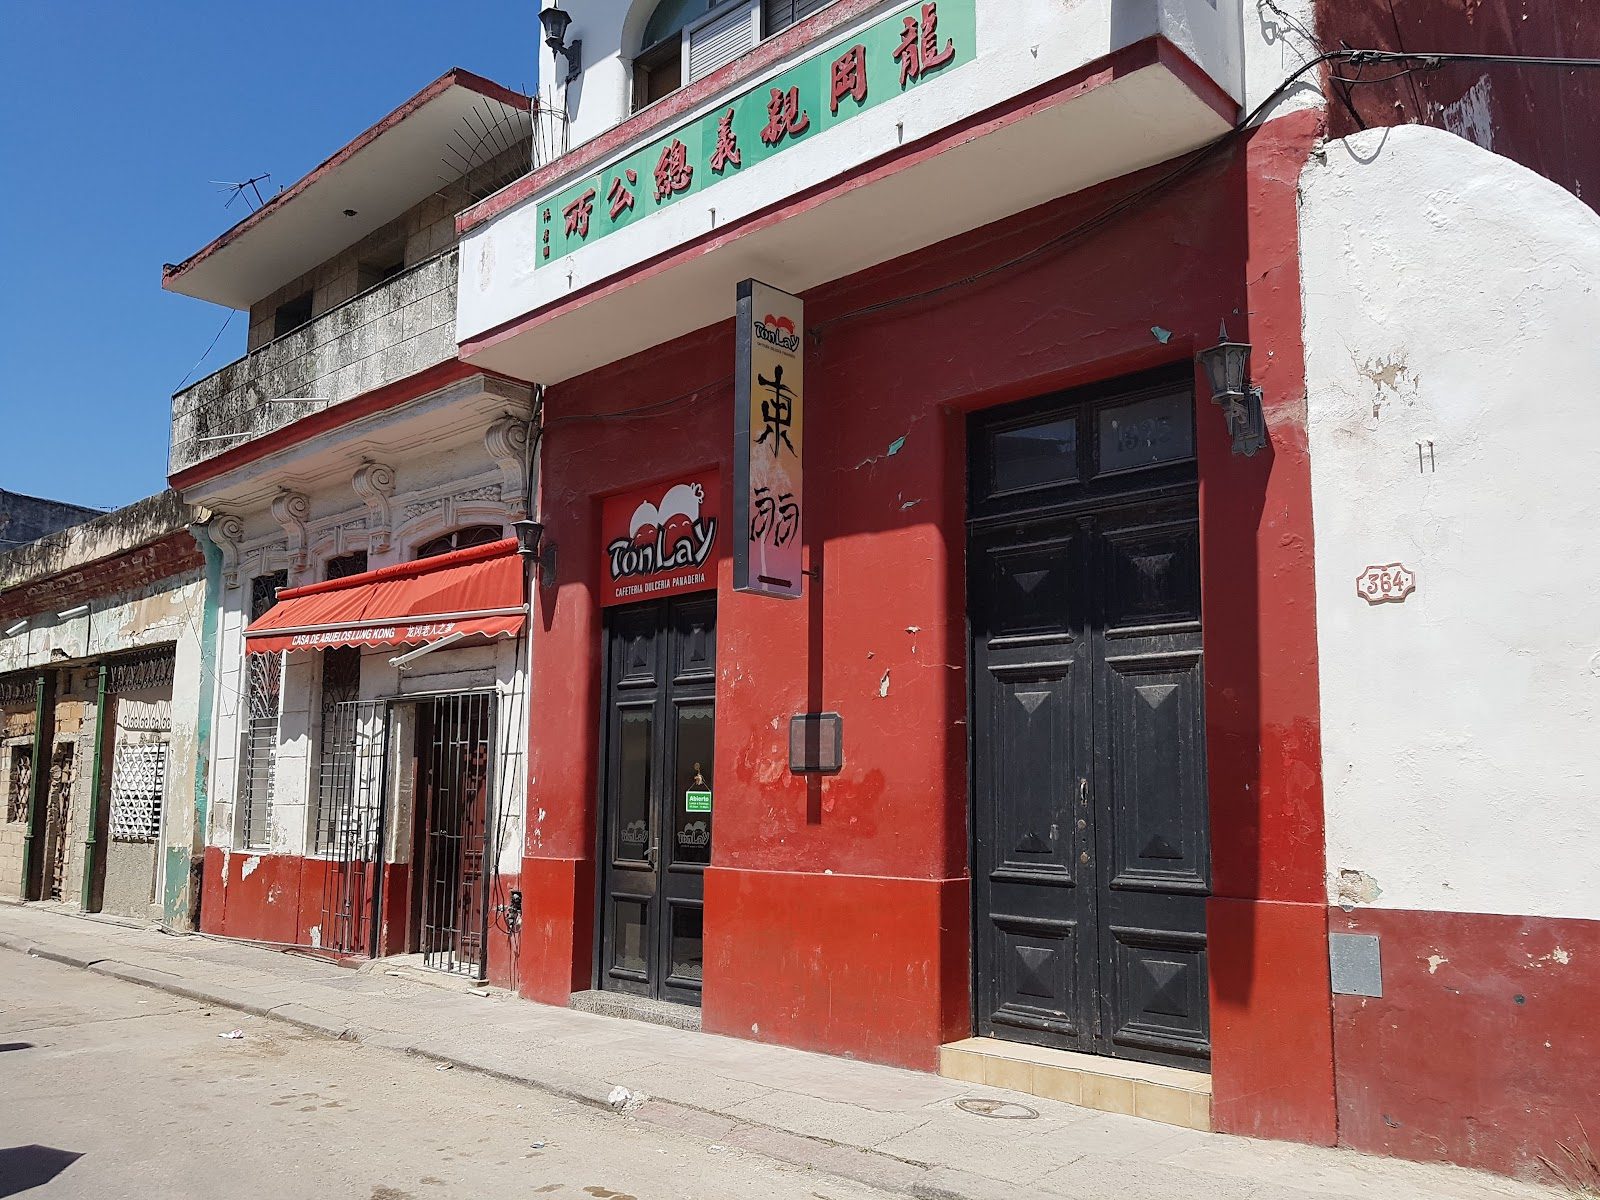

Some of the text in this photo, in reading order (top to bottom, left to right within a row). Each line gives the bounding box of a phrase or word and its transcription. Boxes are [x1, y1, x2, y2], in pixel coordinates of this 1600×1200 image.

[754, 321, 800, 352] TonLay
[607, 517, 718, 582] TonLay
[615, 573, 705, 598] CAFETERIA DULCERIA PANADERIA
[1366, 571, 1404, 594] 364
[292, 627, 396, 646] CASA DE ABUELOS LUNG KONG
